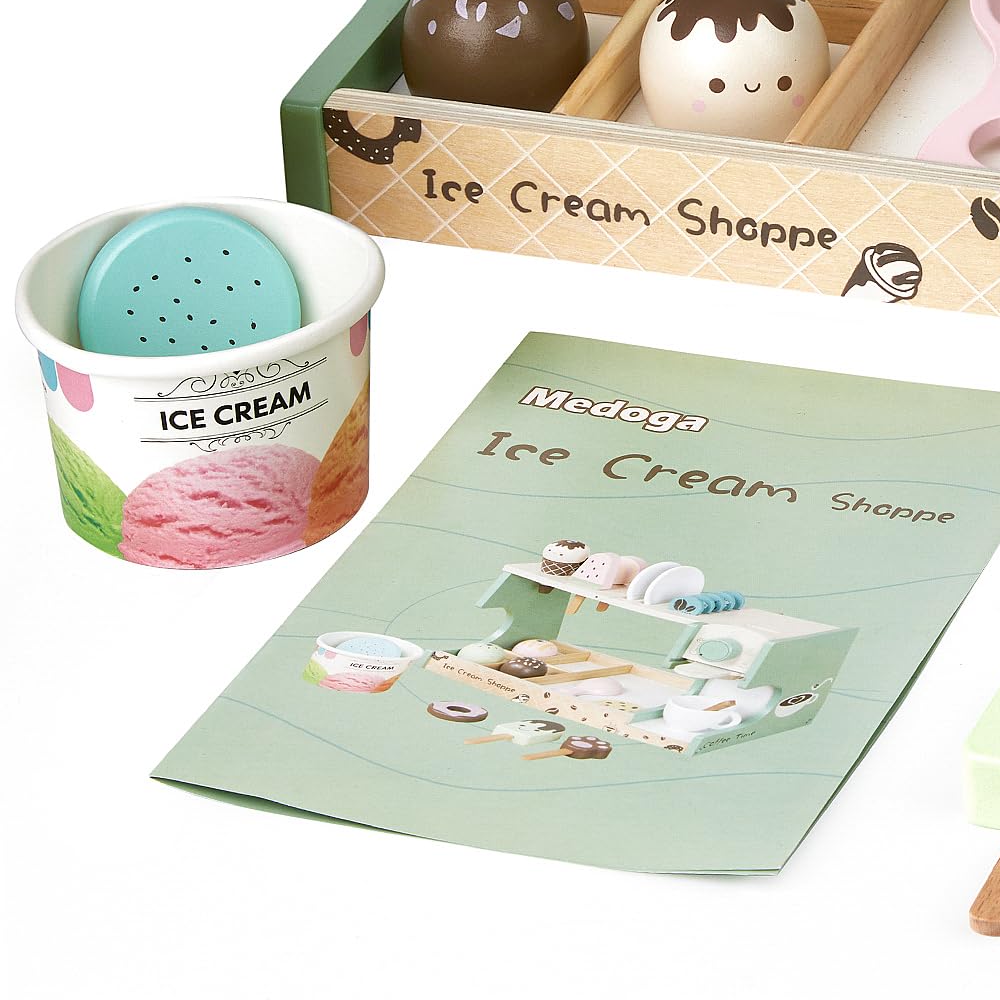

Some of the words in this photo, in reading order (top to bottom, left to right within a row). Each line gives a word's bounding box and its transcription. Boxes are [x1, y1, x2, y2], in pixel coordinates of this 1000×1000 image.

[422, 169, 484, 204] Ice
[510, 180, 650, 226] Cream
[677, 198, 838, 251] Shoppe
[160, 409, 207, 431] ICE
[213, 381, 312, 426] CREAM
[517, 386, 710, 433] Medoga
[476, 430, 571, 466] Ice
[602, 453, 798, 503] Cream
[830, 492, 956, 525] Shoppe
[365, 663, 395, 671] CREAM
[442, 662, 455, 672] Ice
[457, 668, 484, 681] Cream
[487, 678, 516, 693] Shoppe
